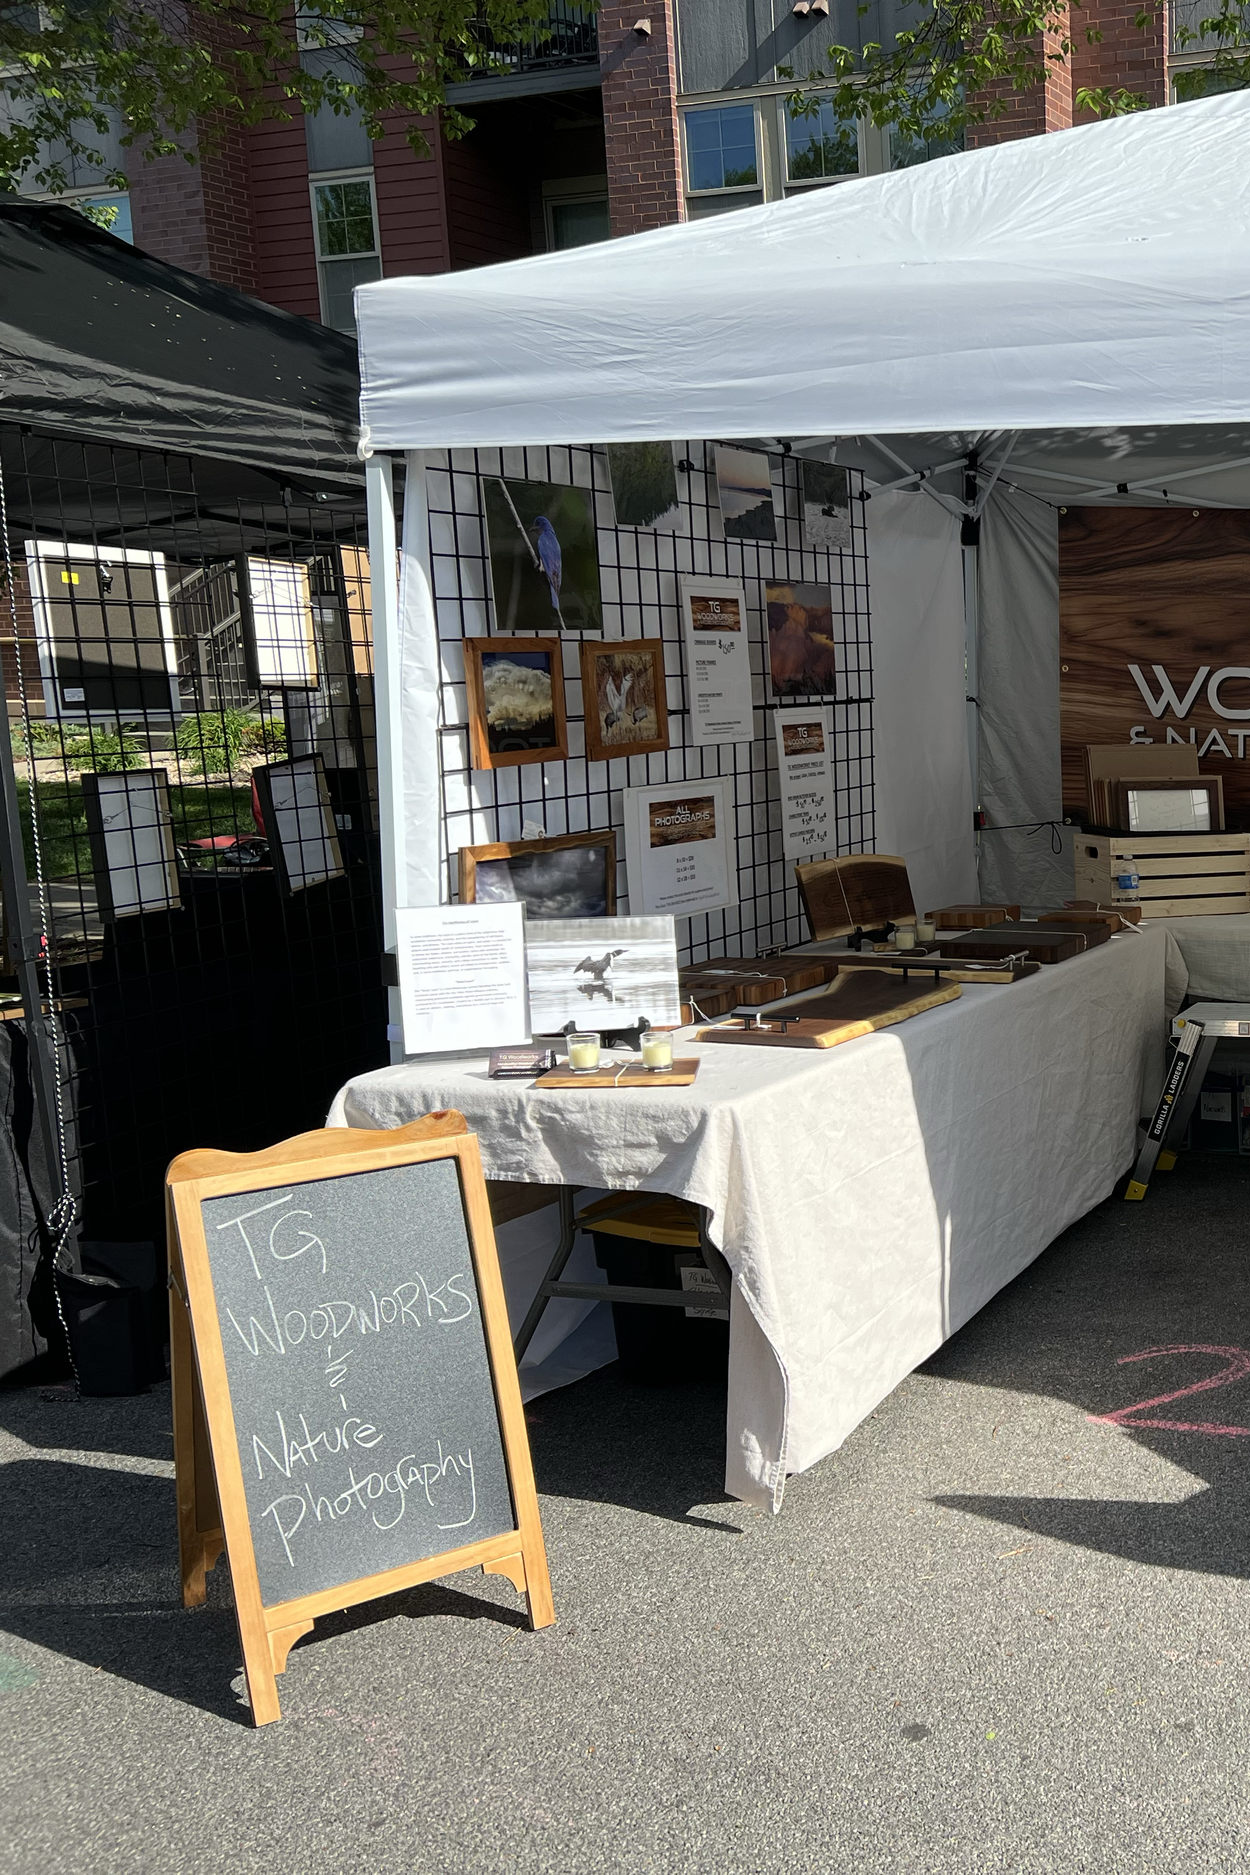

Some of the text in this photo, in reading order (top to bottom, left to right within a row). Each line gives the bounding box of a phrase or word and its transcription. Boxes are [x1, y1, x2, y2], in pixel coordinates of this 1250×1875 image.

[708, 601, 721, 613] TG
[797, 727, 808, 738] TG
[676, 805, 690, 815] ALL
[654, 811, 710, 827] PHOTOGRAPHS
[1153, 1061, 1185, 1135] GORILLA LADDERS
[217, 1194, 327, 1280] TG
[226, 1272, 473, 1356] WOODWORKS
